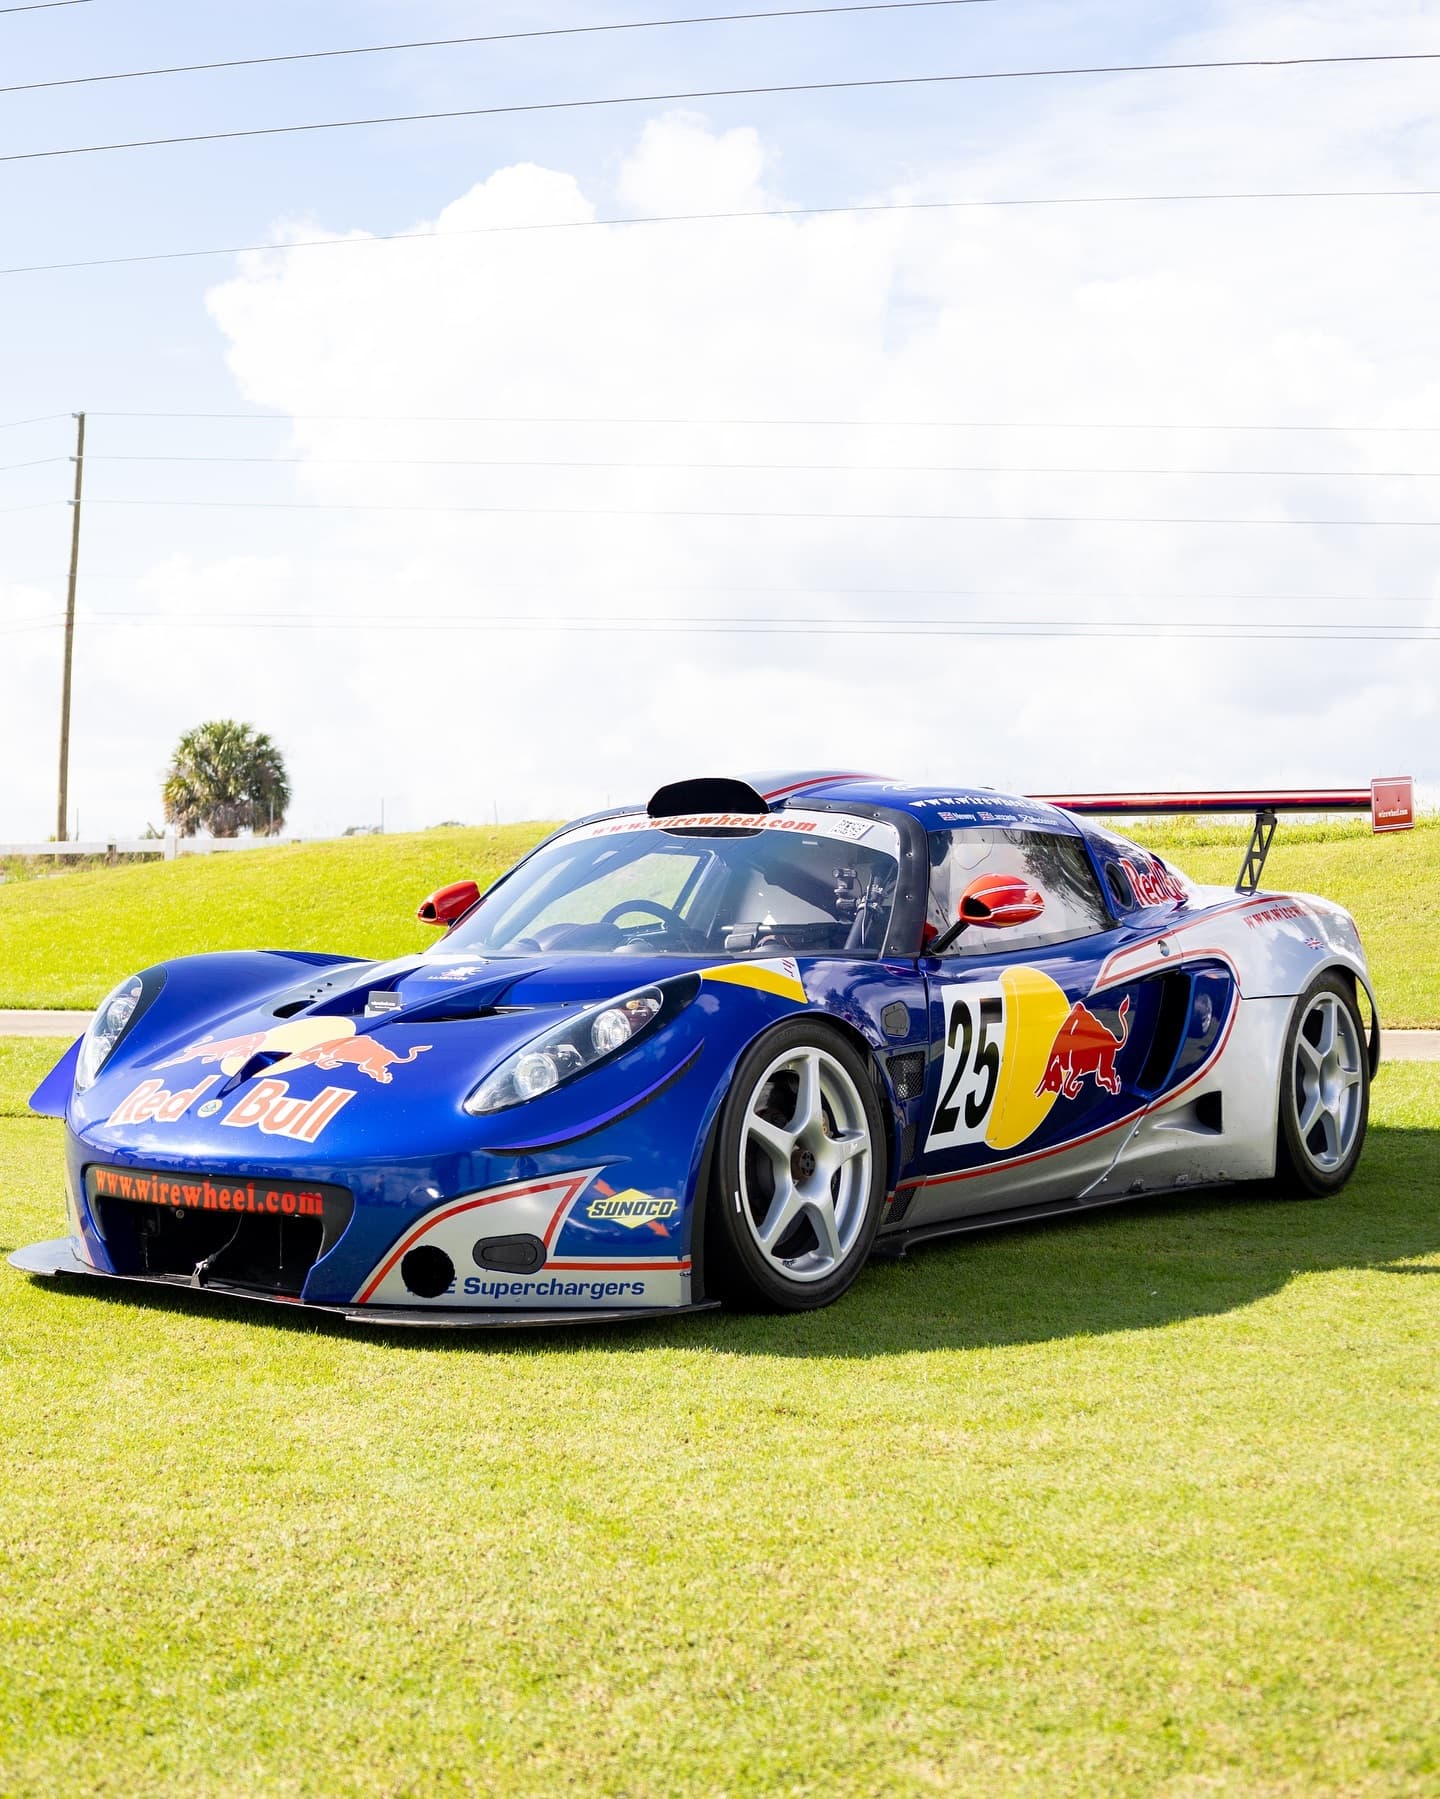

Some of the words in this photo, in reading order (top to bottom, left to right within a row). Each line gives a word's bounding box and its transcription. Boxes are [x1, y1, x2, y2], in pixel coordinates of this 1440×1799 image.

[592, 814, 818, 836] www.wirewheel.com
[930, 997, 1002, 1136] 25
[105, 1074, 221, 1128] Red
[220, 1078, 357, 1143] Bull
[95, 1170, 323, 1216] www.wirewheel.com
[591, 1200, 674, 1217] SUNOCO
[464, 1276, 645, 1299] Superchargers
